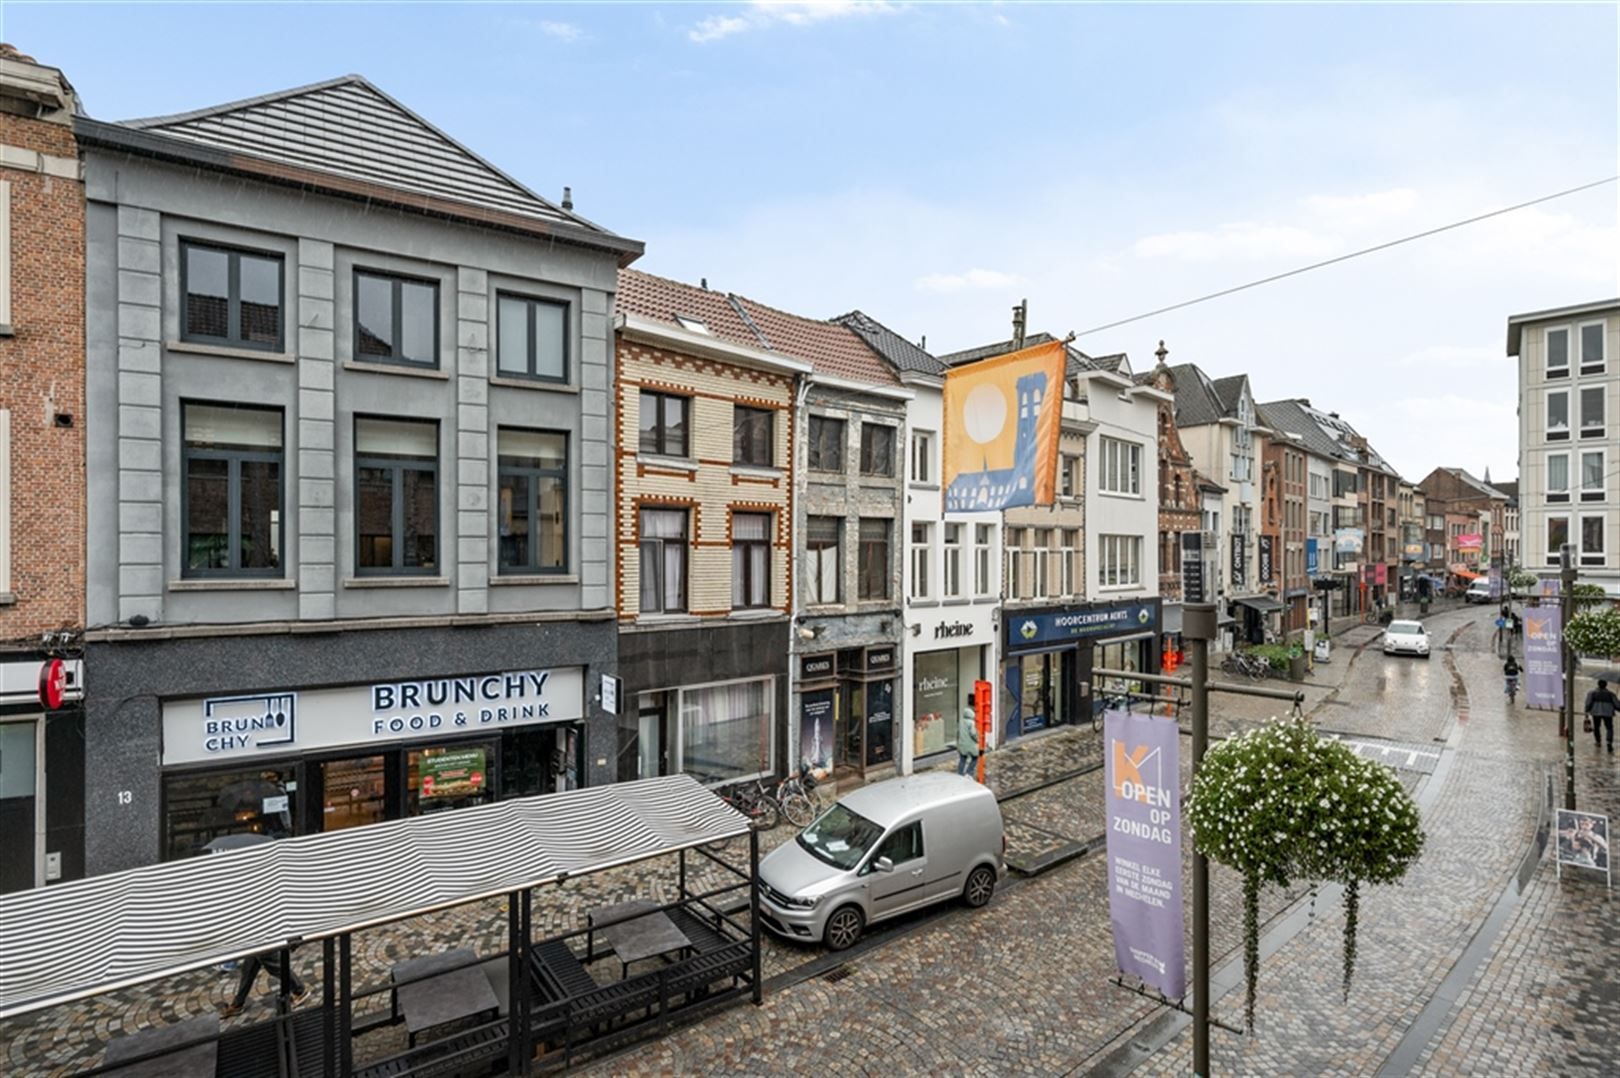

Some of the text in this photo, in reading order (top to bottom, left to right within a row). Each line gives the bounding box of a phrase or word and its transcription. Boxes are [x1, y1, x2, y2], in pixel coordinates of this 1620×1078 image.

[934, 620, 974, 639] rheine
[374, 672, 549, 710] BRUNCHY
[919, 677, 948, 691] rheine
[206, 717, 264, 734] BRUN
[374, 703, 549, 734] FOOD & DRINK
[206, 735, 250, 751] CHY
[118, 791, 132, 804] 13
[1121, 781, 1171, 809] OPEN
[1150, 809, 1171, 825] OP
[1113, 816, 1172, 844] ZONDAG
